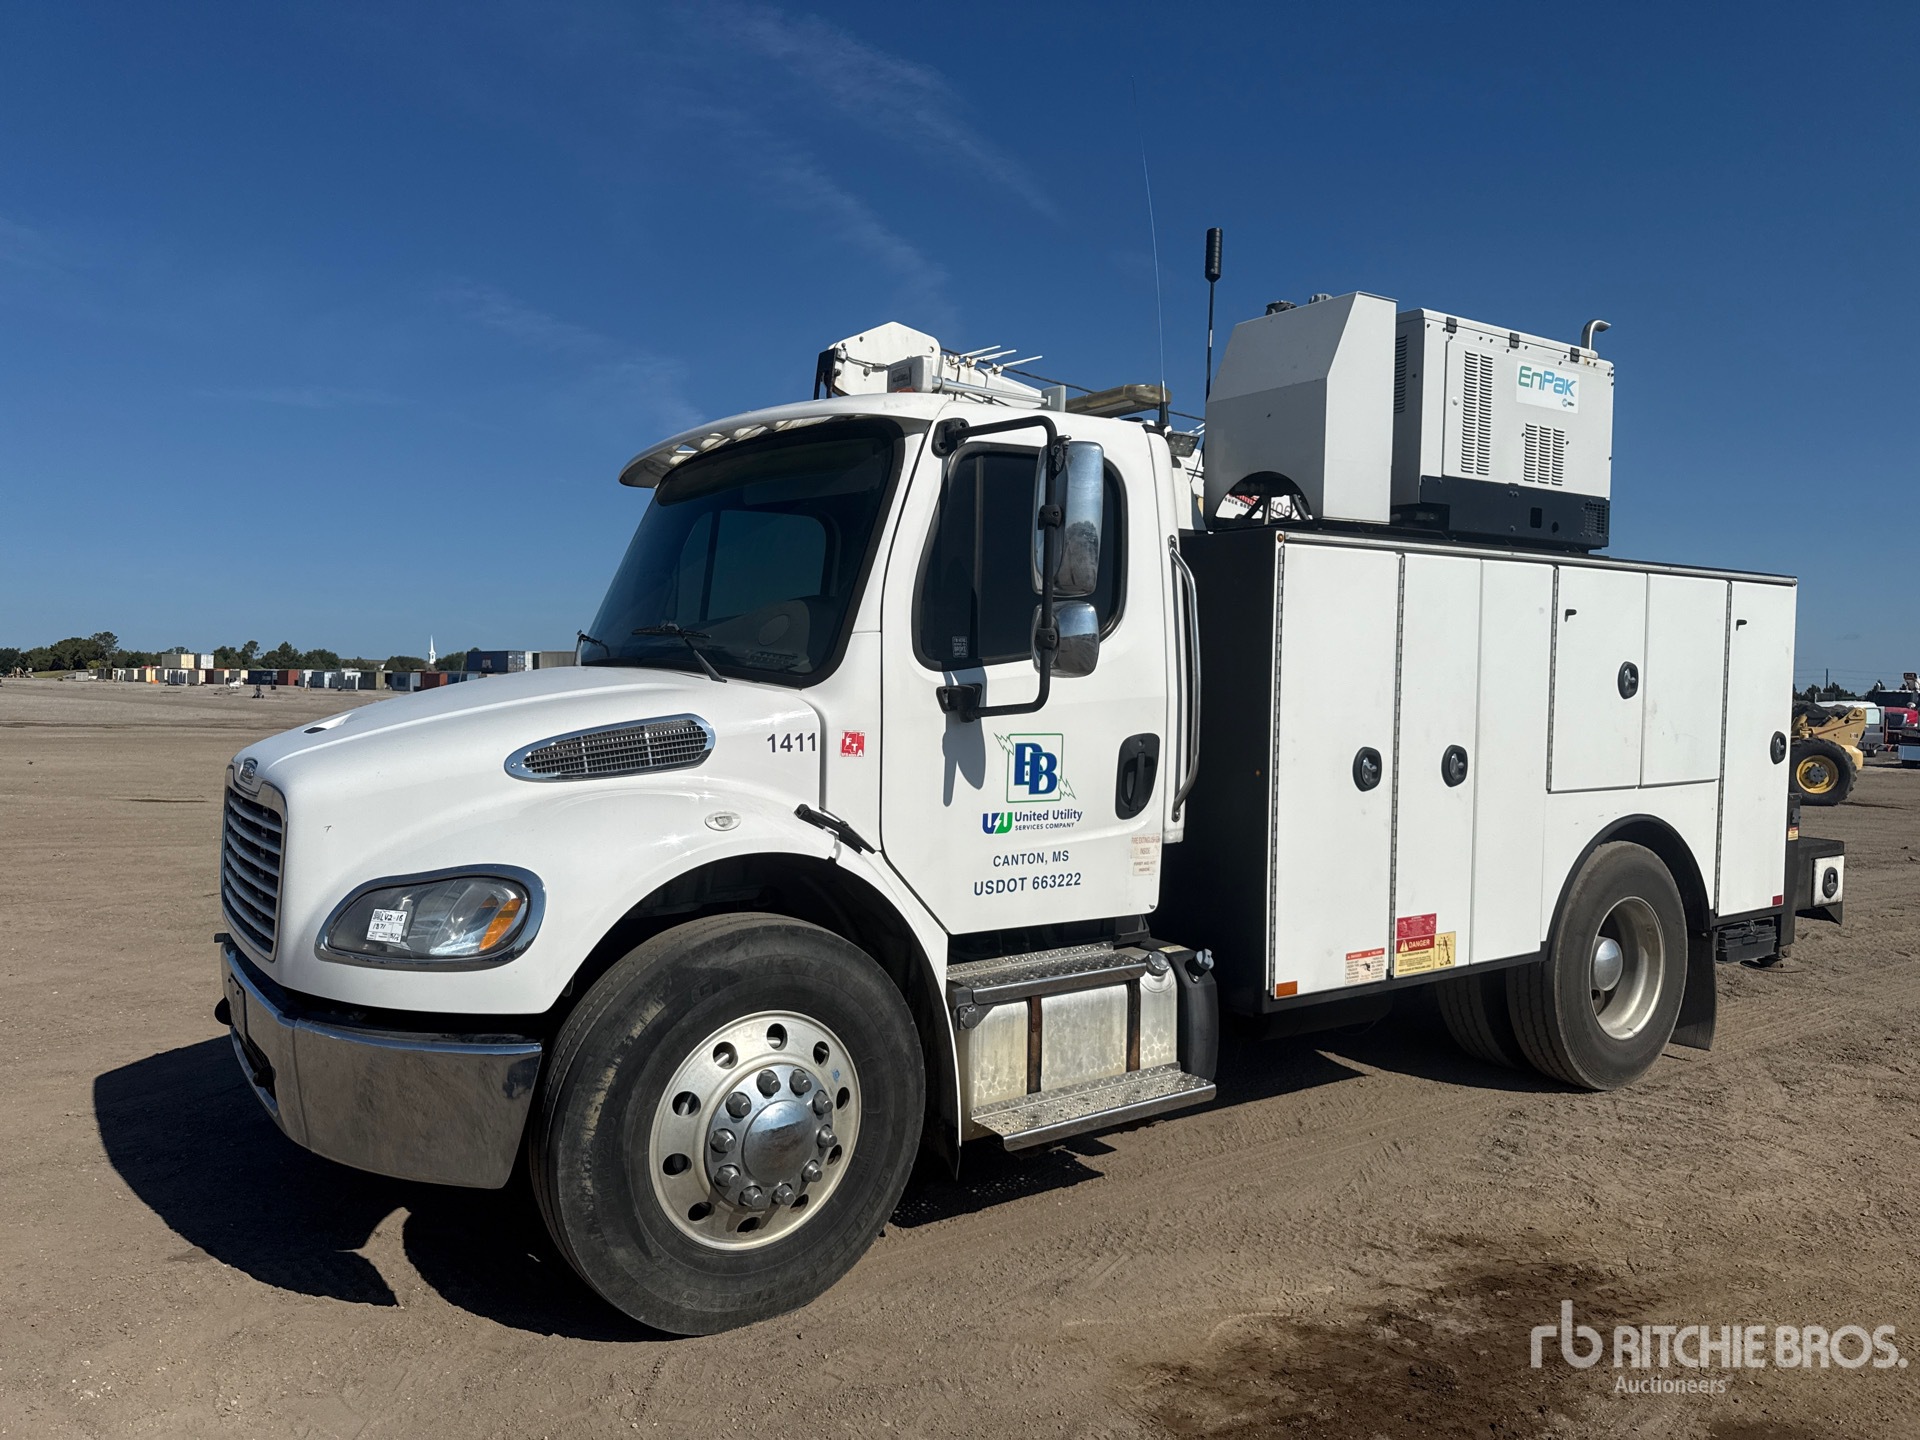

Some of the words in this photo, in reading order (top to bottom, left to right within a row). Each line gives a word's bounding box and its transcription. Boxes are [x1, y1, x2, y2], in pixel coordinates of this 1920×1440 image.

[767, 732, 817, 753] 1411
[1014, 809, 1050, 822] United
[1052, 808, 1083, 822] Utility
[1045, 822, 1075, 830] COMPANY
[993, 852, 1048, 867] CANTON,
[1052, 850, 1070, 862] MS
[973, 876, 1027, 896] USDOT
[1032, 872, 1081, 890] 663222
[1408, 939, 1431, 948] DANGER
